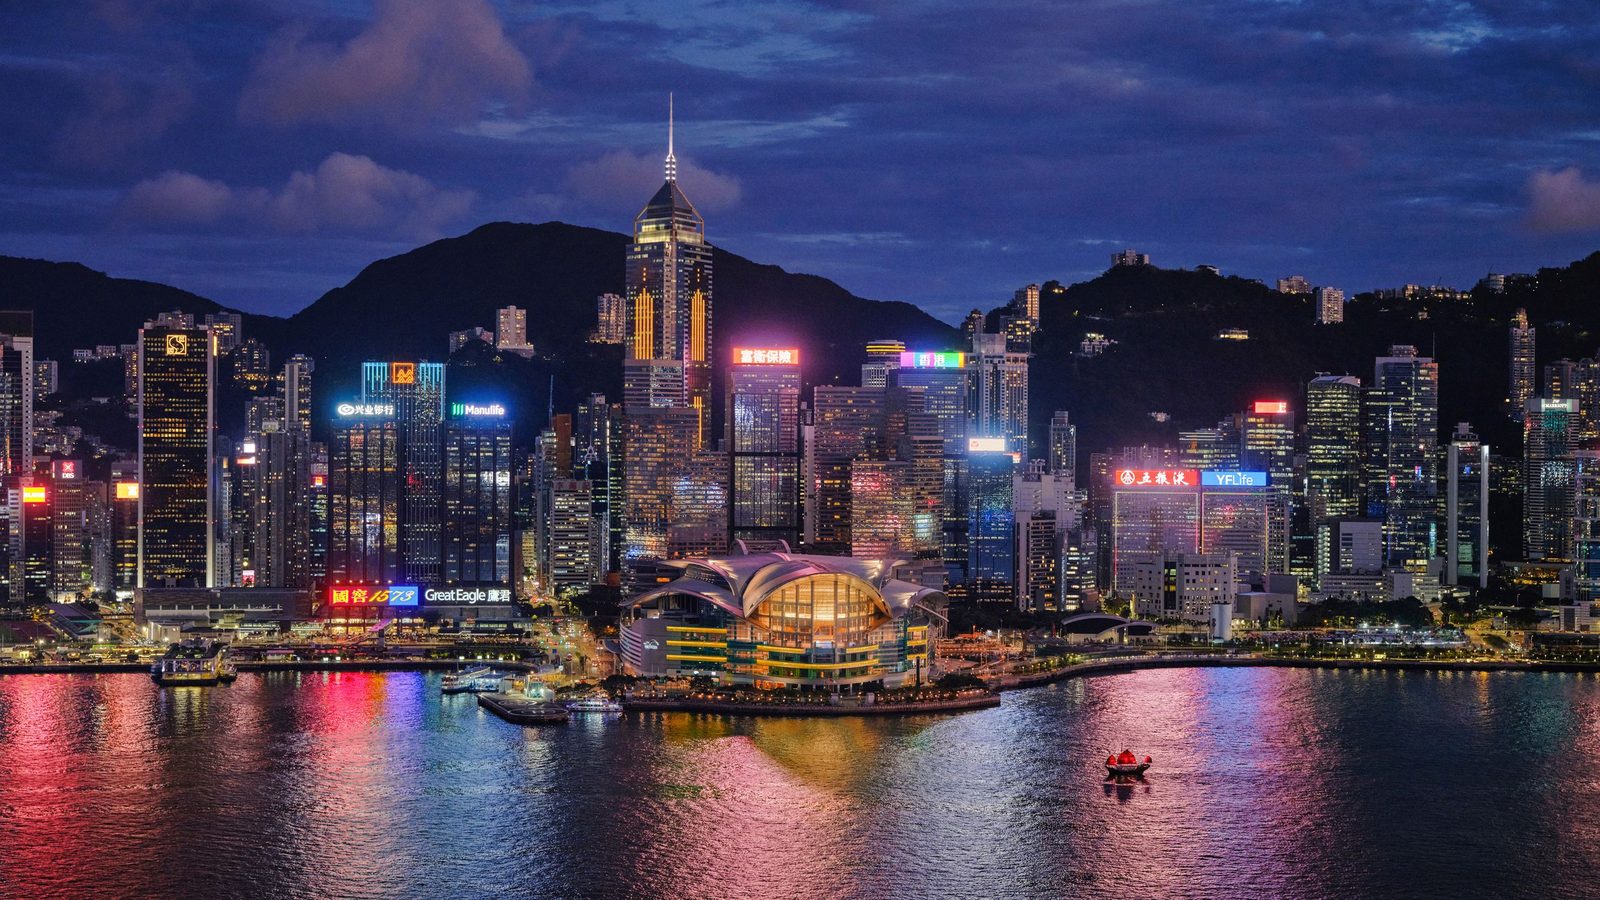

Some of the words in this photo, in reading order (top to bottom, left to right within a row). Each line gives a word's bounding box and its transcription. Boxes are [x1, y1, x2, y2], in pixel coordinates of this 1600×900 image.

[465, 404, 504, 415] Manulife
[425, 589, 455, 601] Great
[456, 588, 486, 604] Eagle
